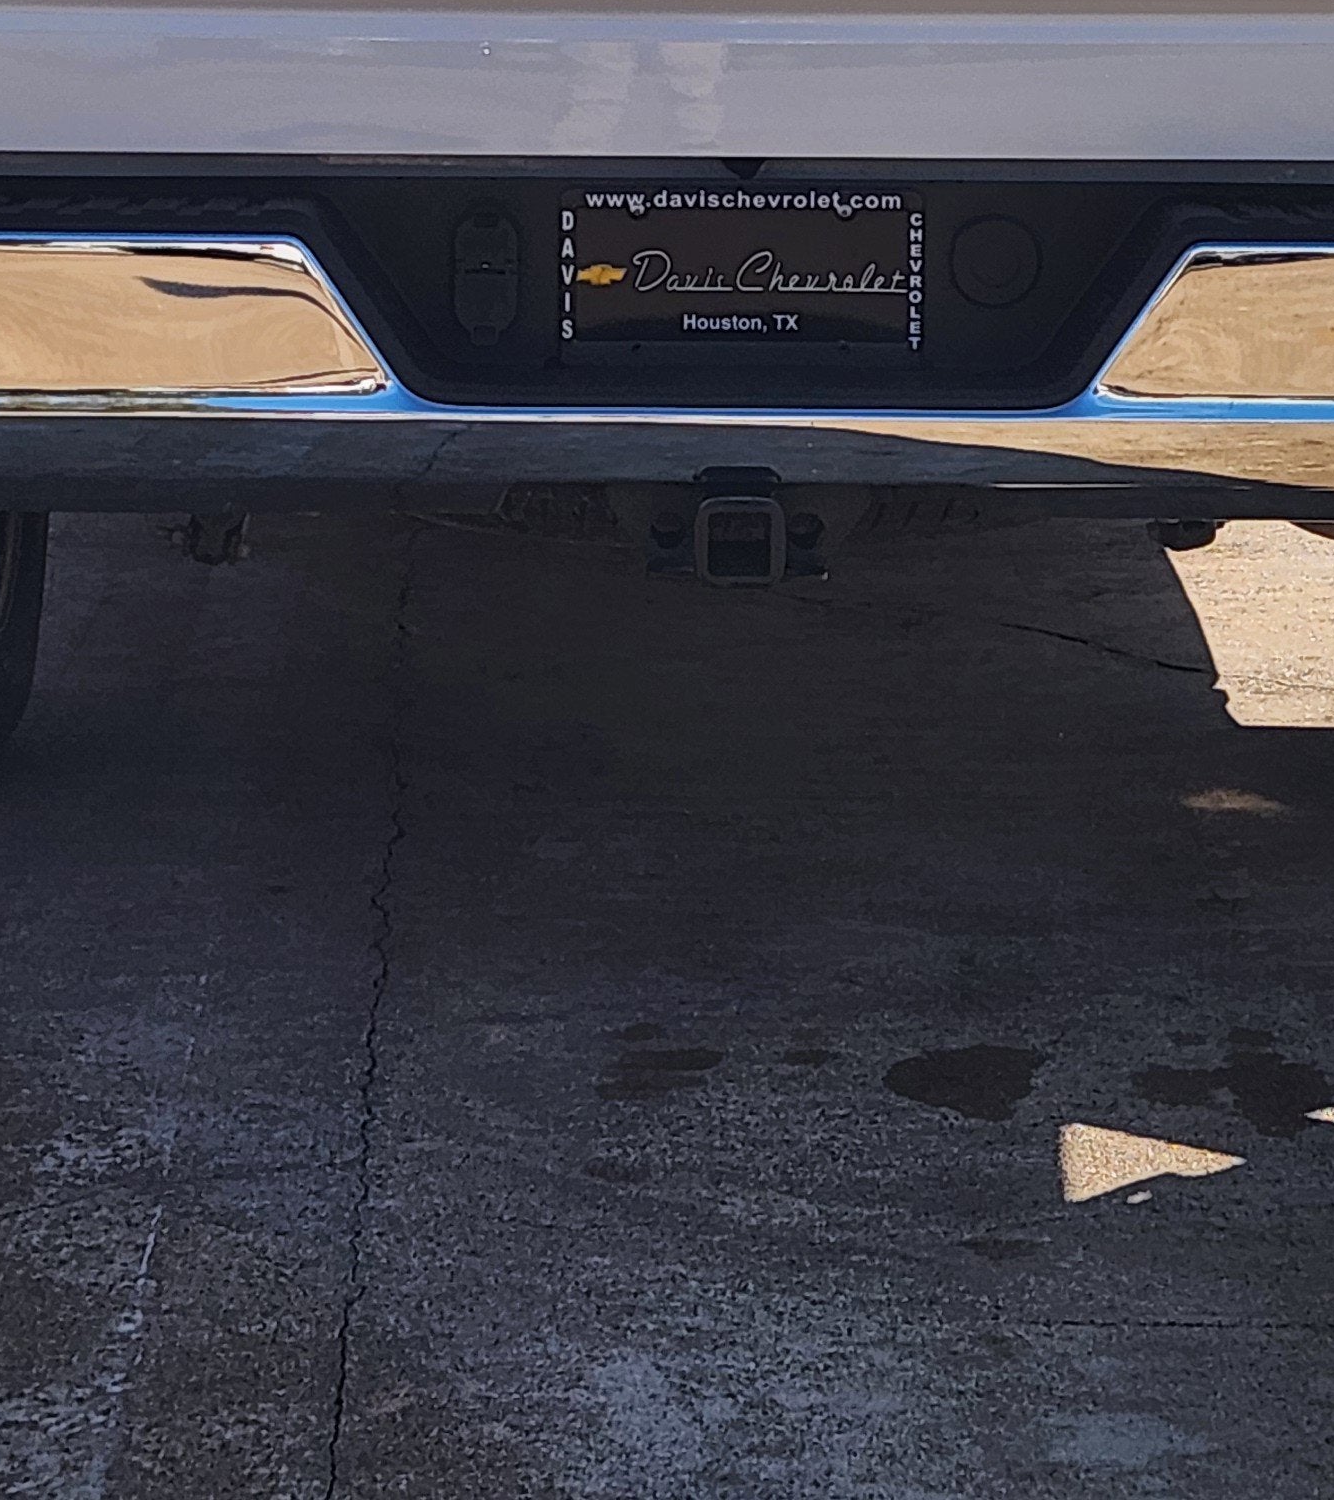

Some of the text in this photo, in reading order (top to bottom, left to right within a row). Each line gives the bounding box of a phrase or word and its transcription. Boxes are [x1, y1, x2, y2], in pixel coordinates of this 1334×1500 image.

[585, 189, 902, 210] www.davischevrolet.com
[561, 211, 575, 340] DAVIS
[632, 249, 908, 294] Davis Chevrolet
[908, 212, 924, 350] CHEVROLET
[682, 314, 799, 333] Houston, TX
